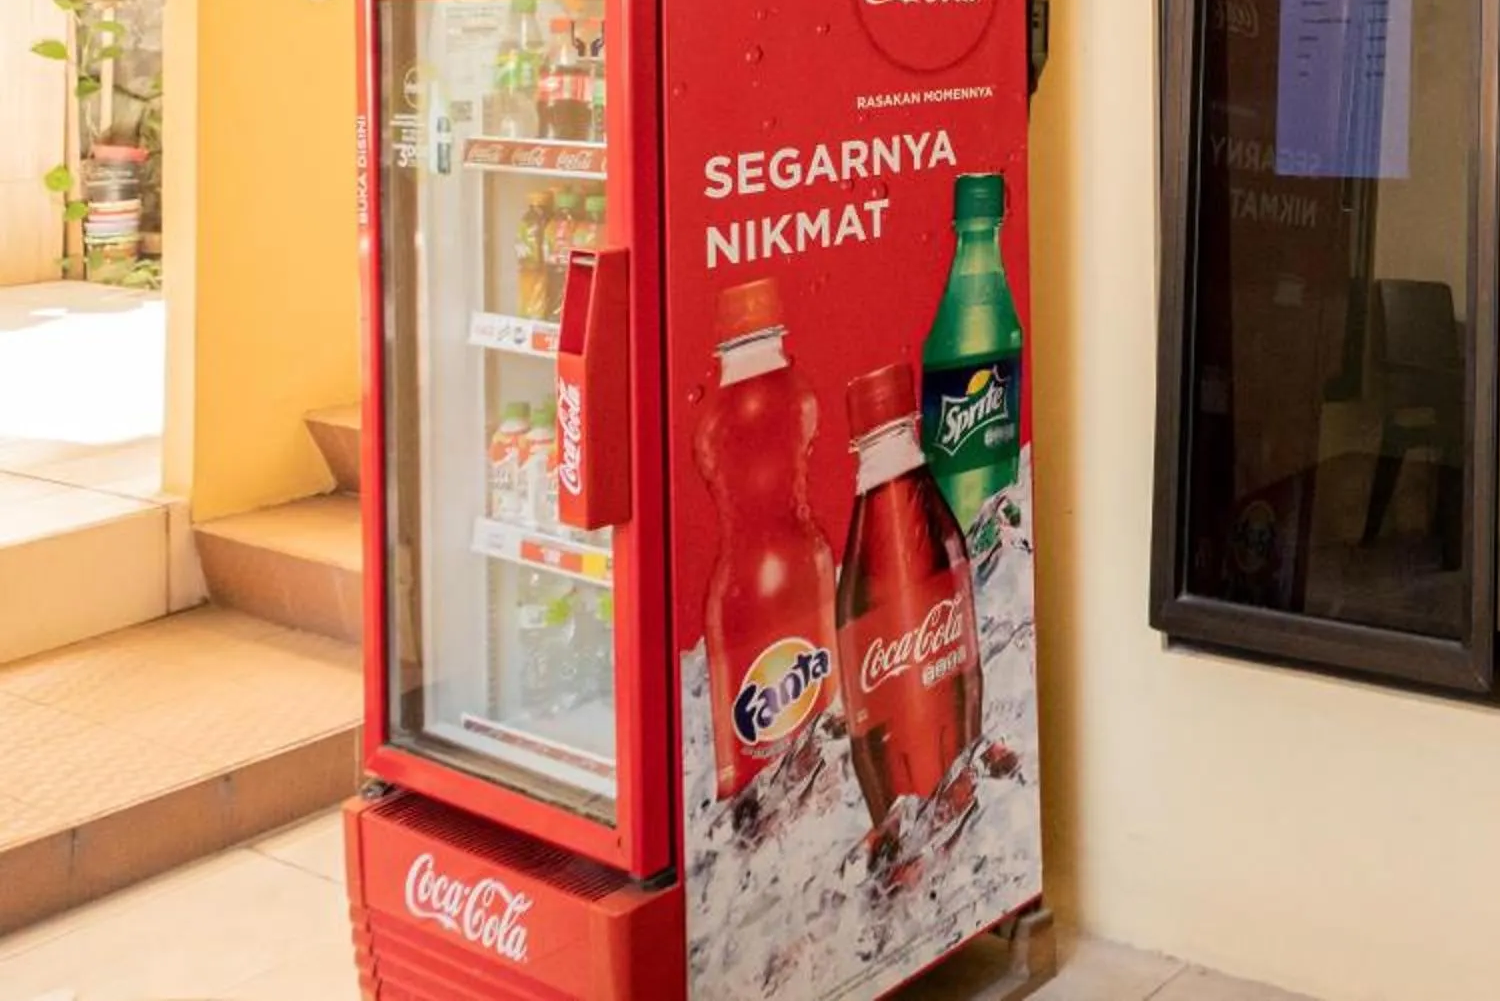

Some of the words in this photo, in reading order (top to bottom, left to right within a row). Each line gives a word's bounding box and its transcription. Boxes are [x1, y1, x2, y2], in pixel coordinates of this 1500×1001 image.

[857, 91, 921, 109] RASAKAN
[923, 86, 993, 102] MOMENNYA
[704, 130, 957, 199] SEGARNYA
[706, 199, 888, 269] NIKMAT
[941, 380, 1004, 444] Sprite
[862, 599, 963, 693] Coca-Cola
[732, 648, 830, 744] Fanta
[406, 853, 532, 962] Coca-Cola
